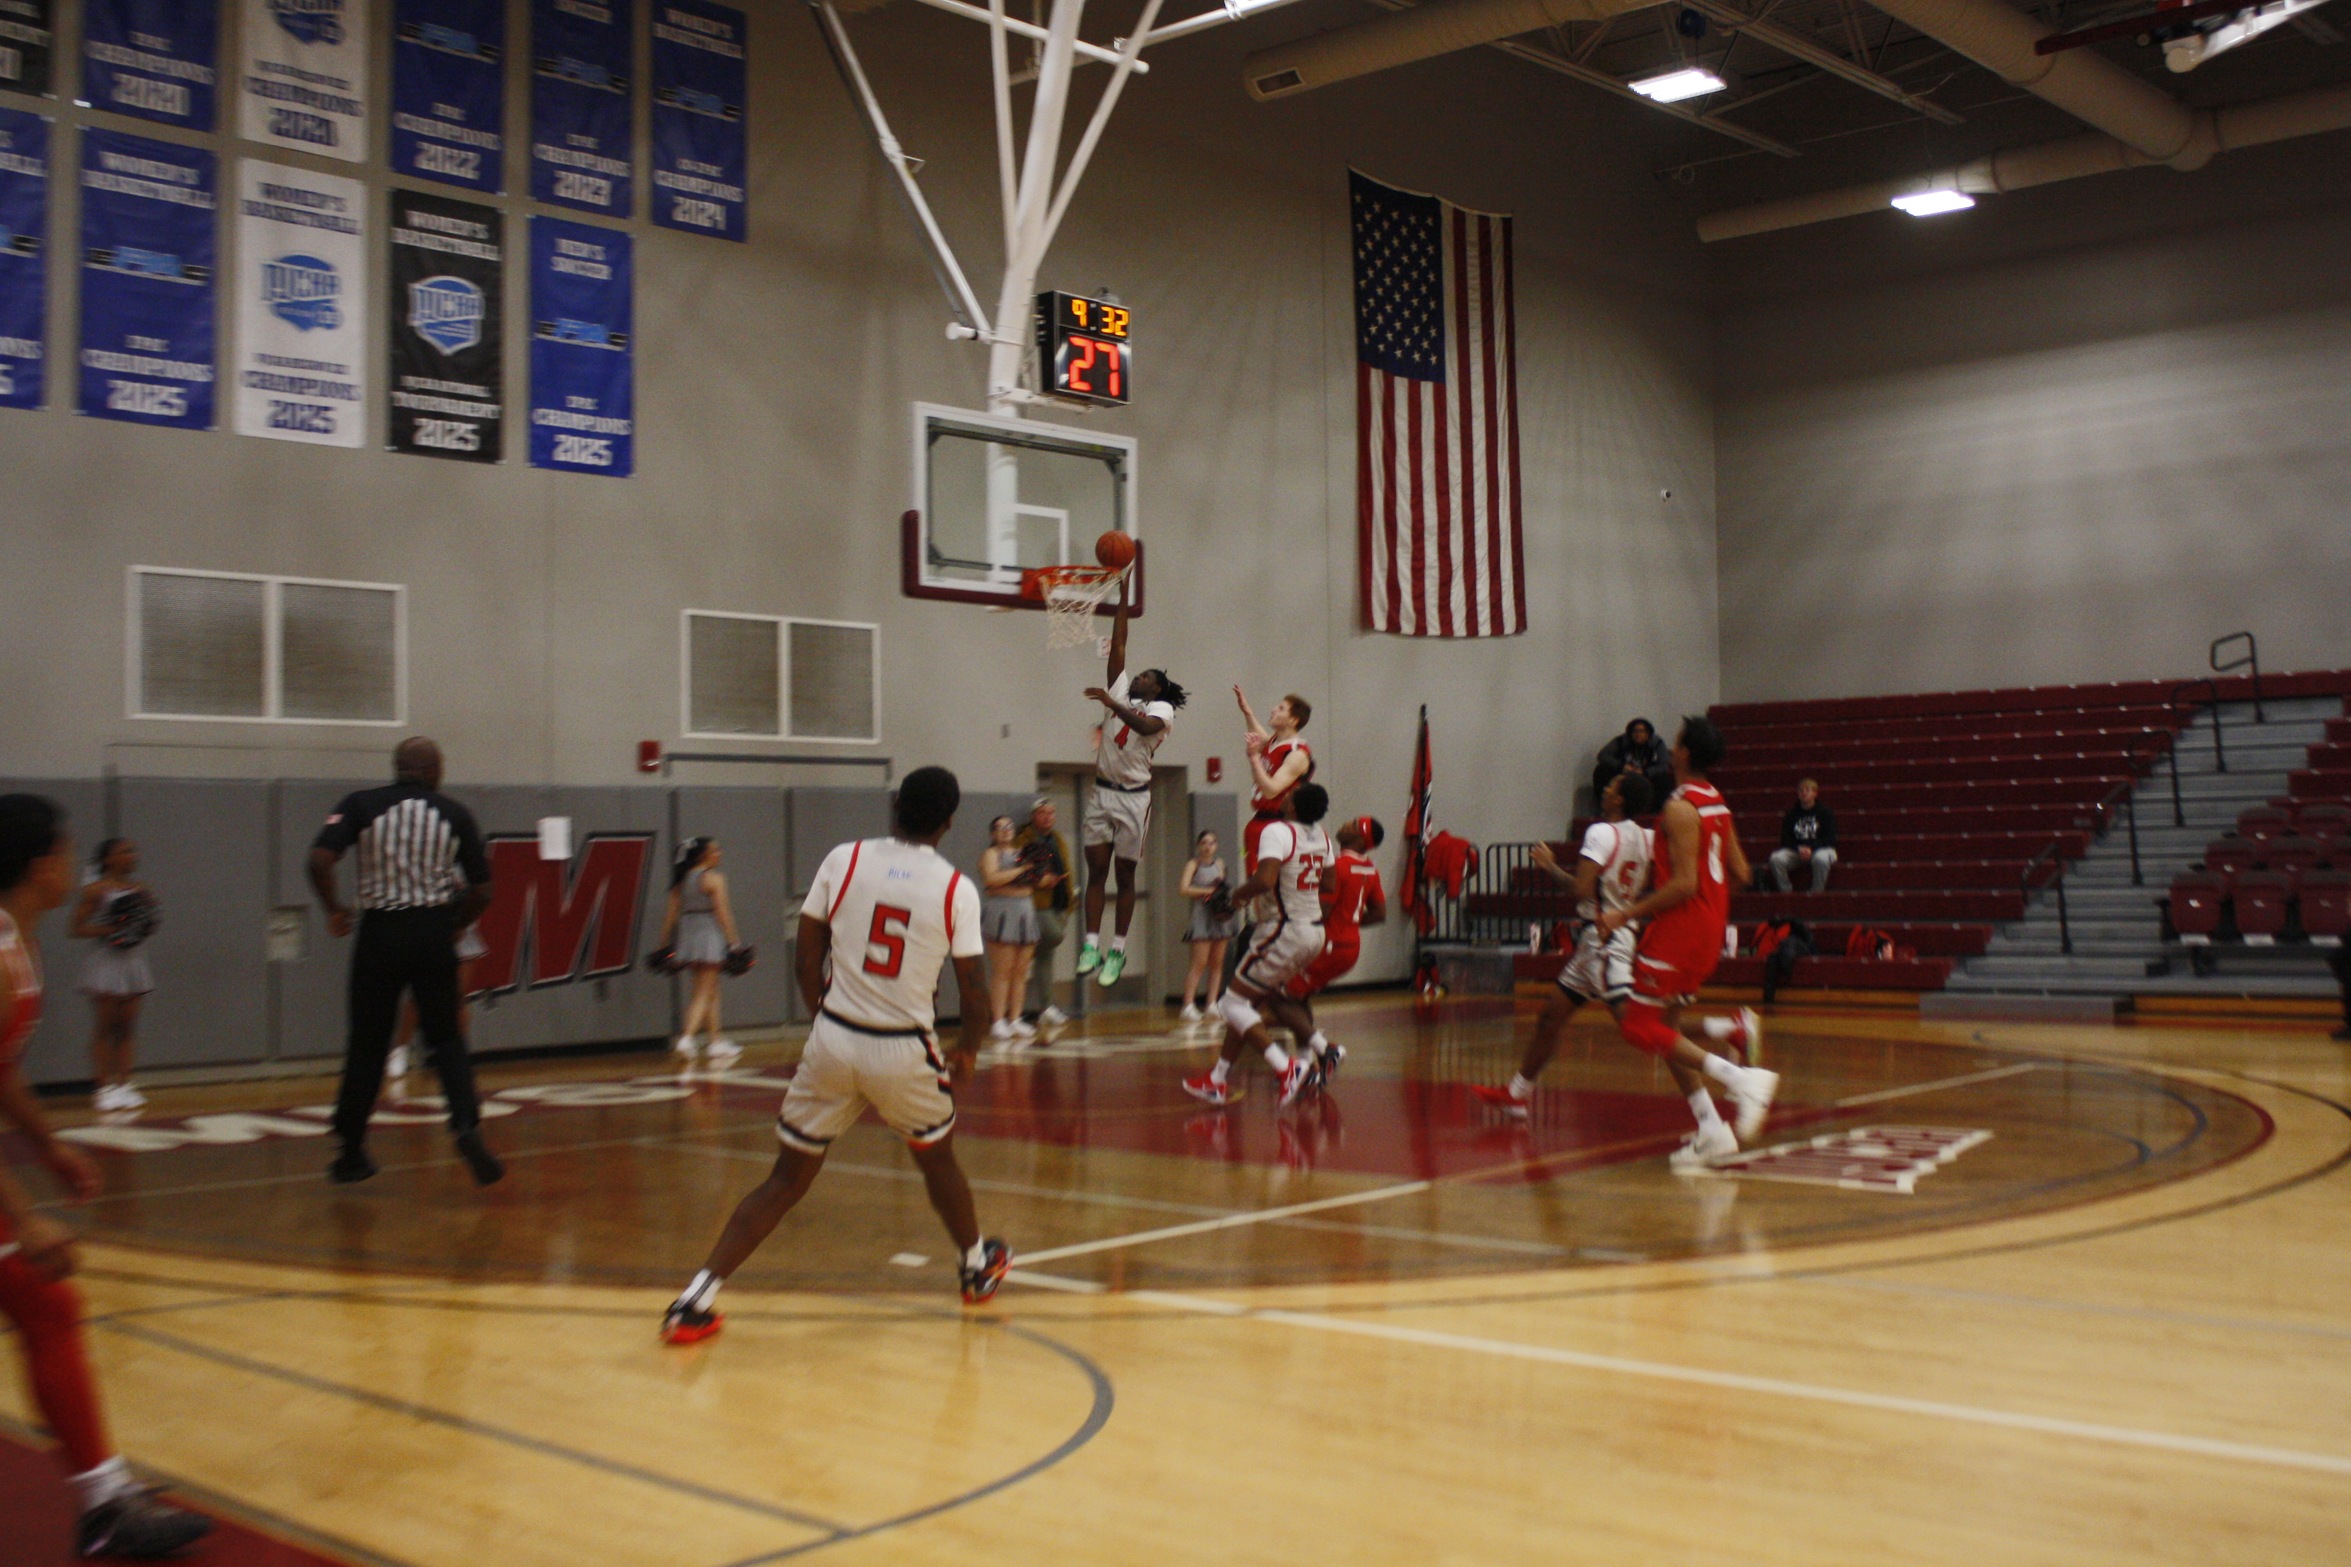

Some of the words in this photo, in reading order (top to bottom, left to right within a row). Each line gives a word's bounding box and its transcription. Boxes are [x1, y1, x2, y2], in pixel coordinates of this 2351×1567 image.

[1068, 335, 1120, 397] 27
[106, 379, 188, 417] 2025
[266, 400, 339, 434] 2025
[412, 416, 482, 451] 2025
[551, 433, 613, 467] 2025
[862, 902, 912, 979] 5
